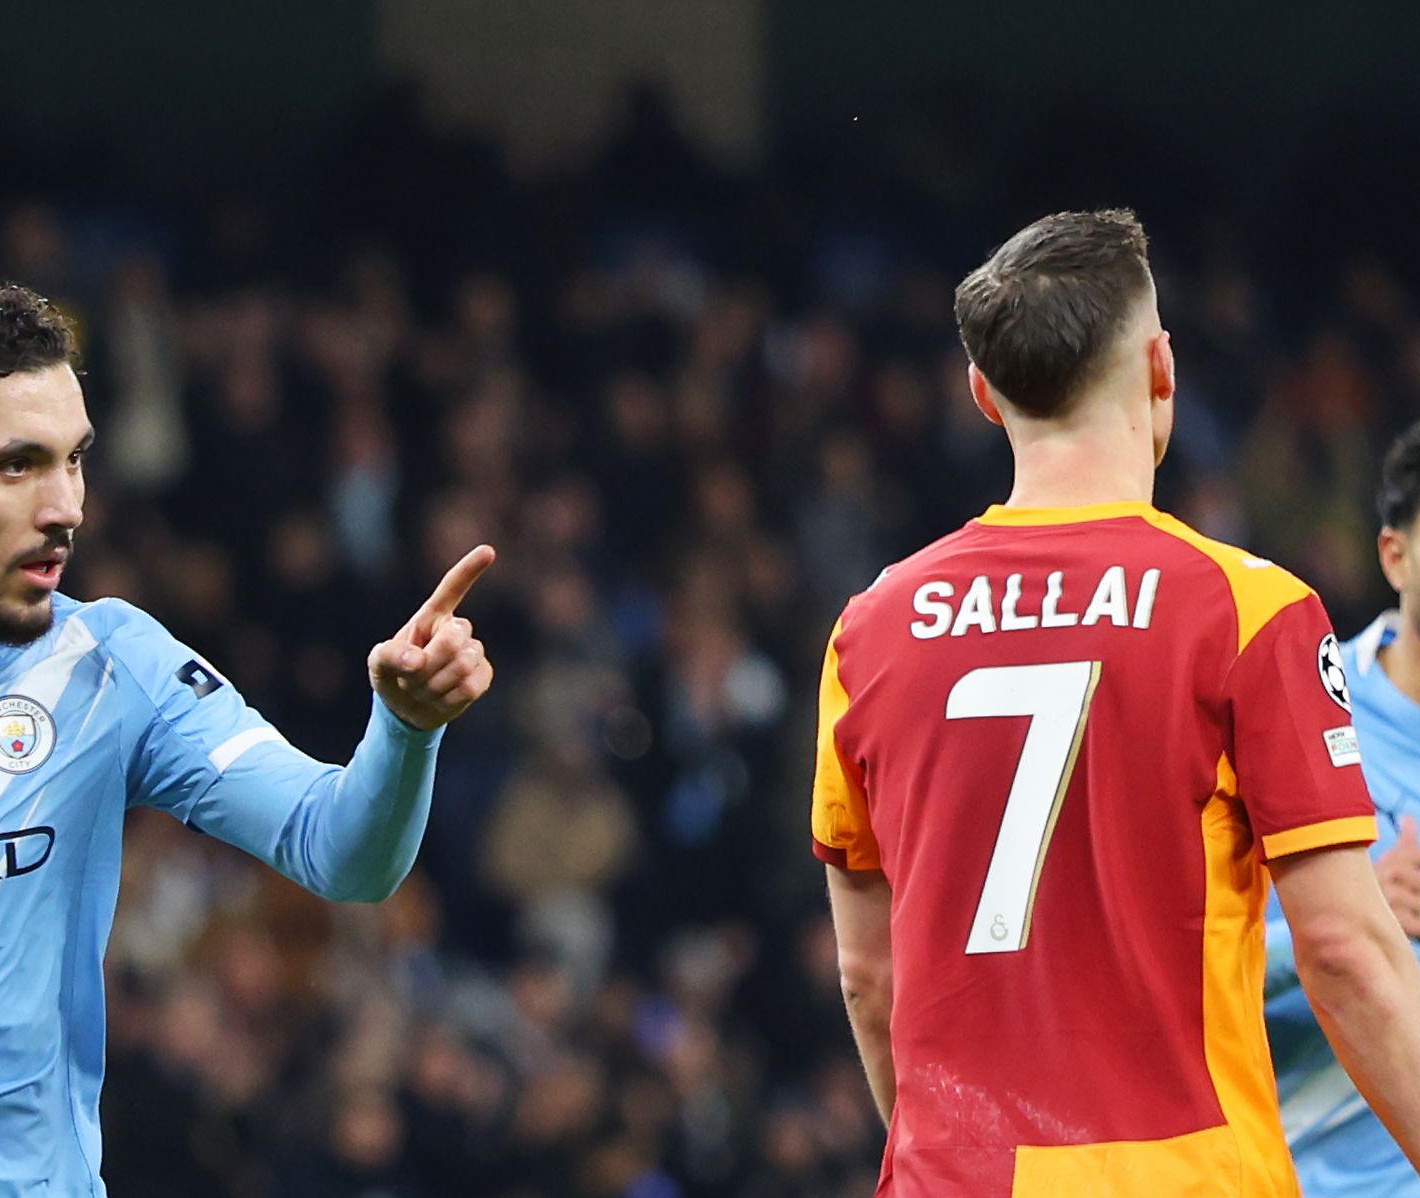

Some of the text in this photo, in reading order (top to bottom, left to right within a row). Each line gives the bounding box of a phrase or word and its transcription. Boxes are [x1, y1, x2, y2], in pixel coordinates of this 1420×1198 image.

[910, 566, 1162, 640] SALLAI
[8, 760, 31, 769] CITY
[945, 661, 1103, 955] 7
